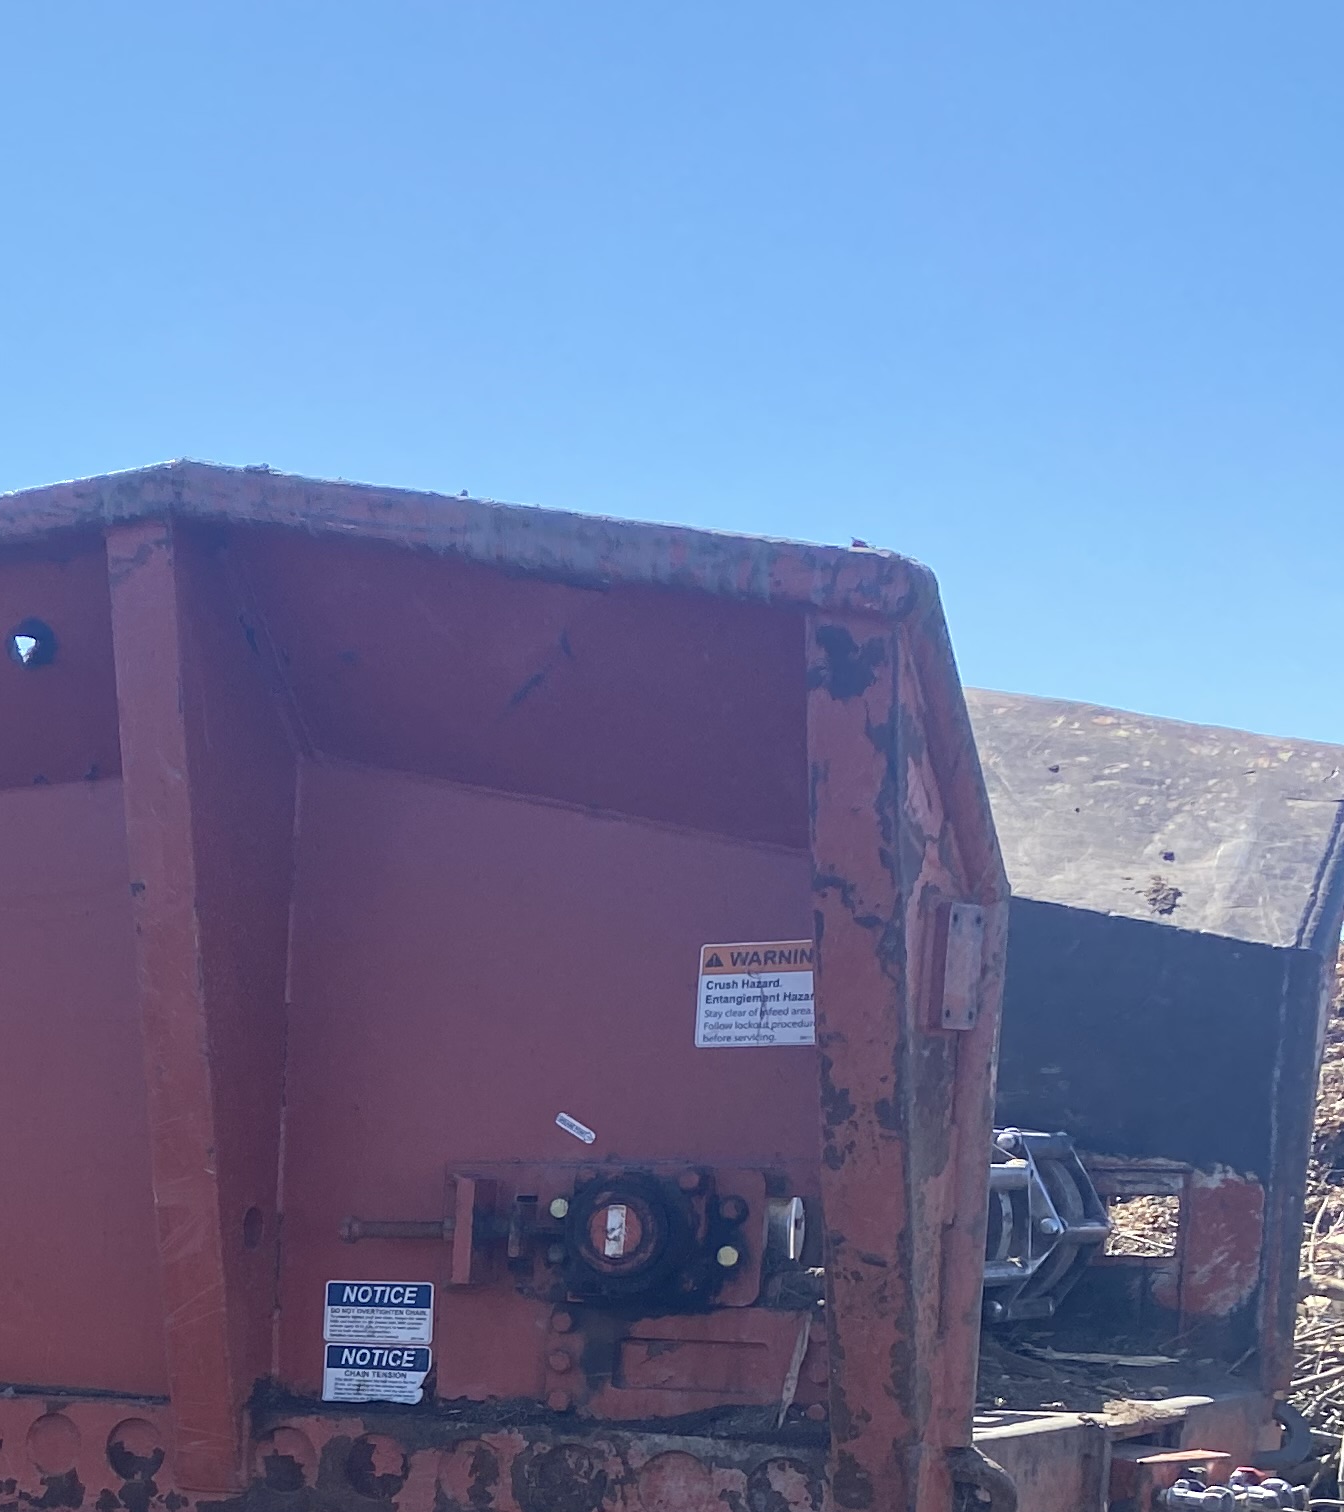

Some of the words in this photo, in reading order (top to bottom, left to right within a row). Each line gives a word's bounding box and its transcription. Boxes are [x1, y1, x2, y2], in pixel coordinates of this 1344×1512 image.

[730, 948, 813, 967] WARNIN
[706, 980, 738, 990] Crush
[705, 993, 780, 1005] Entanglement
[783, 992, 814, 1001] Hazar
[704, 1009, 723, 1019] Stay
[725, 1009, 746, 1017] clear
[748, 1008, 758, 1017] of
[703, 1021, 733, 1030] Follow
[735, 1020, 769, 1030] lockout
[702, 1034, 731, 1042] before
[342, 1286, 418, 1304] NOTICE
[341, 1348, 416, 1367] NOTICE
[344, 1370, 369, 1378] CHAIN
[372, 1371, 407, 1379] TENSION
